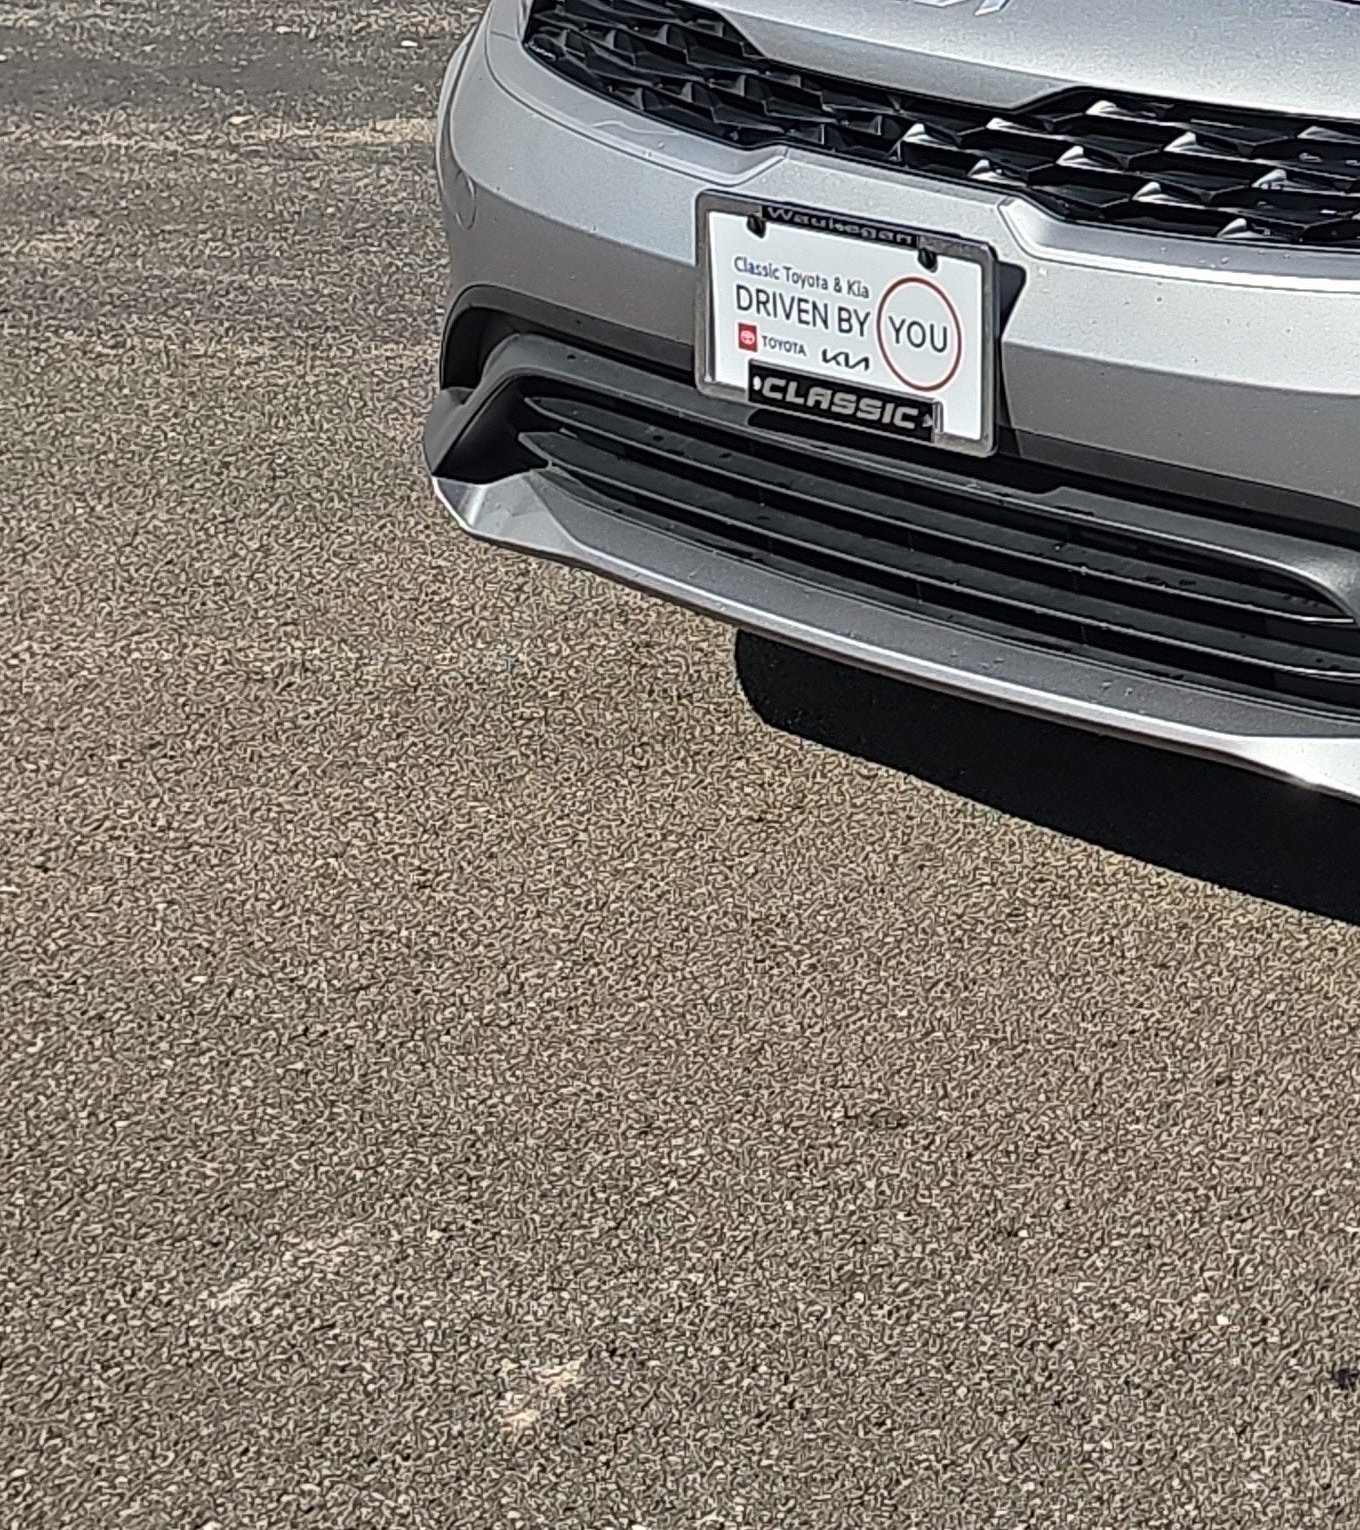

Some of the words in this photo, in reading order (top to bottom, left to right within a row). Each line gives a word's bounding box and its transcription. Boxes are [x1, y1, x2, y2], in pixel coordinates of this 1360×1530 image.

[767, 206, 912, 245] Waukegan
[734, 256, 780, 281] Classic
[783, 265, 829, 290] Toyota
[833, 276, 843, 293] &
[847, 279, 870, 299] Kia
[736, 284, 829, 330] DRIVEN
[838, 306, 871, 338] BY
[888, 315, 948, 353] YOU
[762, 335, 807, 357] TOYOTA
[822, 348, 870, 371] KIA
[762, 377, 919, 429] CLASSIC
